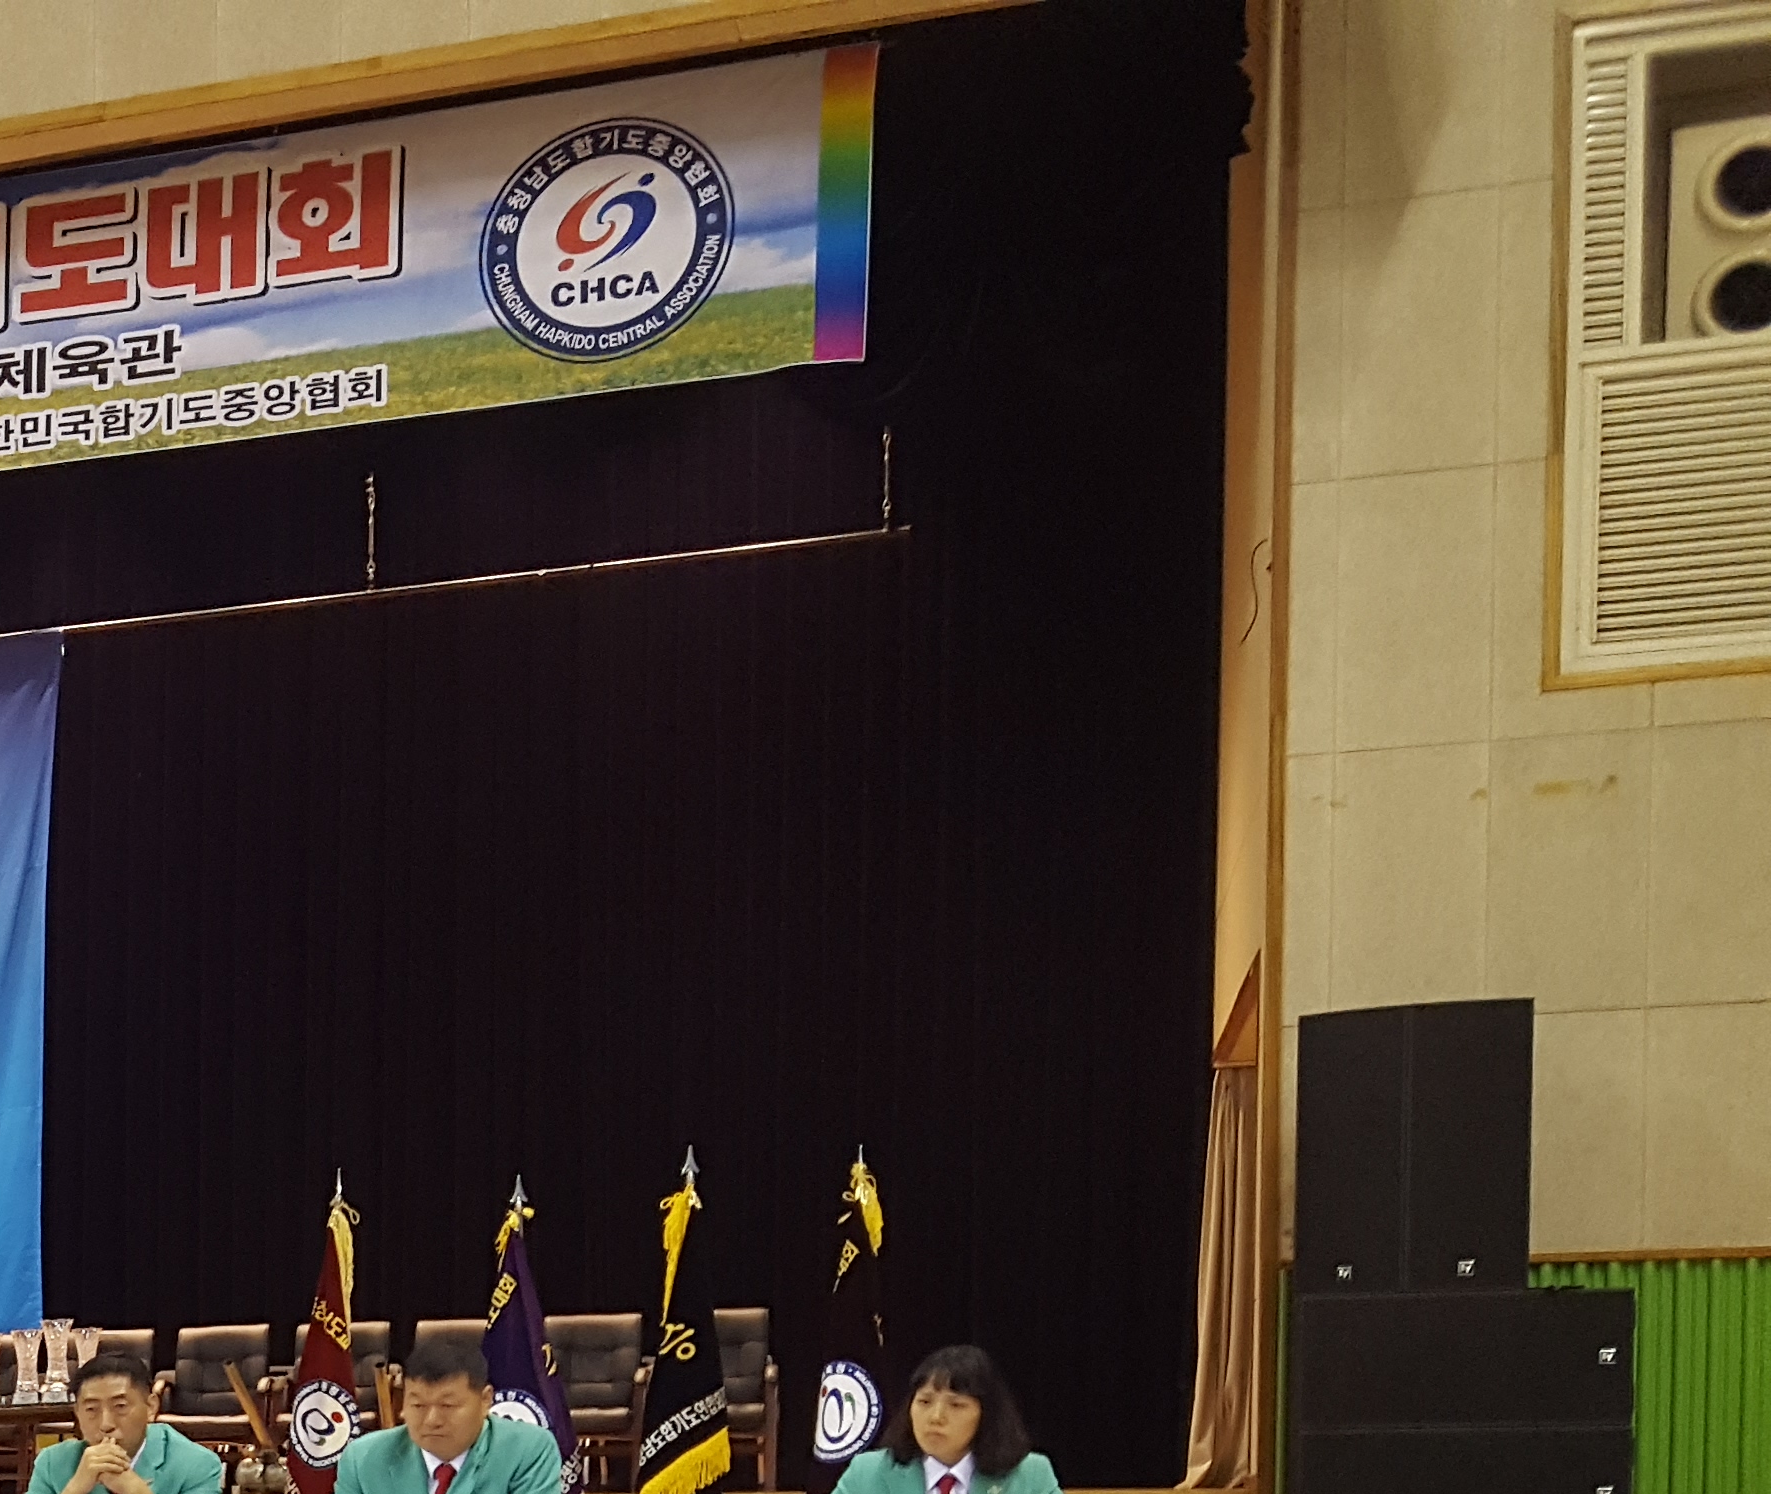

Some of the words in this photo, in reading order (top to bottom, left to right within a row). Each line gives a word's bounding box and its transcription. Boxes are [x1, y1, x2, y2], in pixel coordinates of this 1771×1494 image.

[496, 128, 720, 235] 충청남도합기도중앙협회
[493, 262, 539, 332] CHUNGNAM
[535, 321, 596, 350] HAPKIDO
[598, 314, 667, 350] CENTRAL
[665, 233, 721, 320] ASSOCIATION
[551, 270, 661, 308] CHCA
